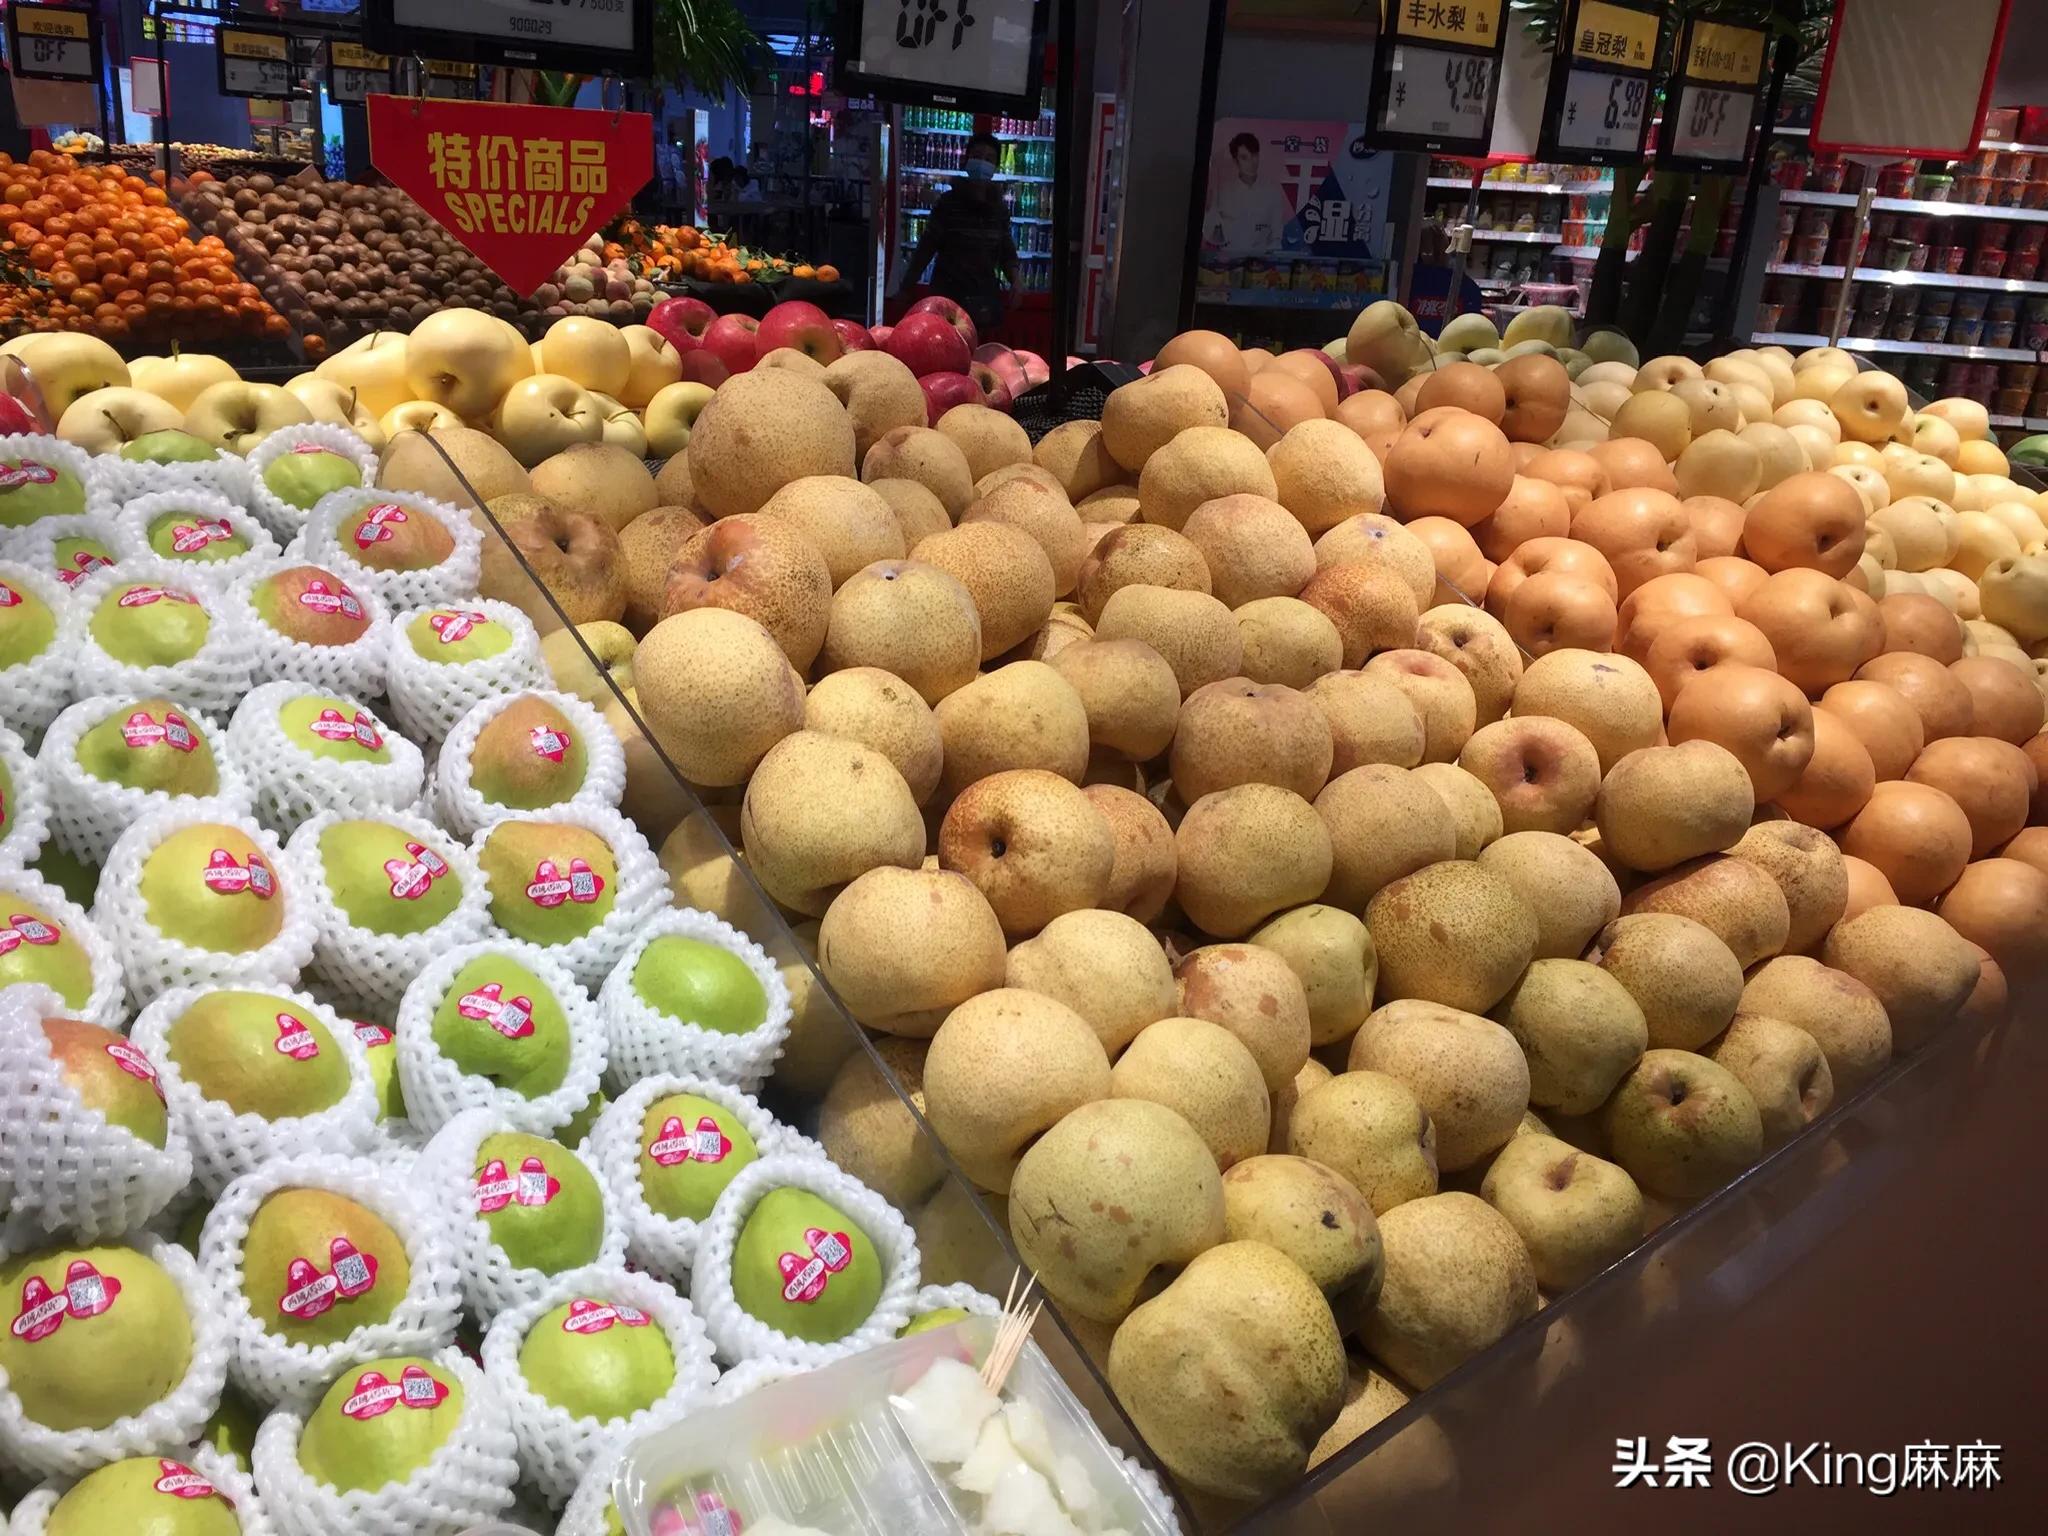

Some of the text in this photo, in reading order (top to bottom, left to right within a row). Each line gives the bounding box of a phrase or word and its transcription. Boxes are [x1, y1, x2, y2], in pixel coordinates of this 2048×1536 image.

[509, 16, 552, 34] 900029
[1407, 0, 1466, 32] 丰水梨
[33, 38, 67, 63] OFF
[1578, 28, 1628, 59] 皇冠梨
[1604, 77, 1646, 129] 6.98
[1690, 89, 1731, 137] OFF
[427, 131, 608, 194] 特价商品
[444, 191, 595, 235] SPECIALS
